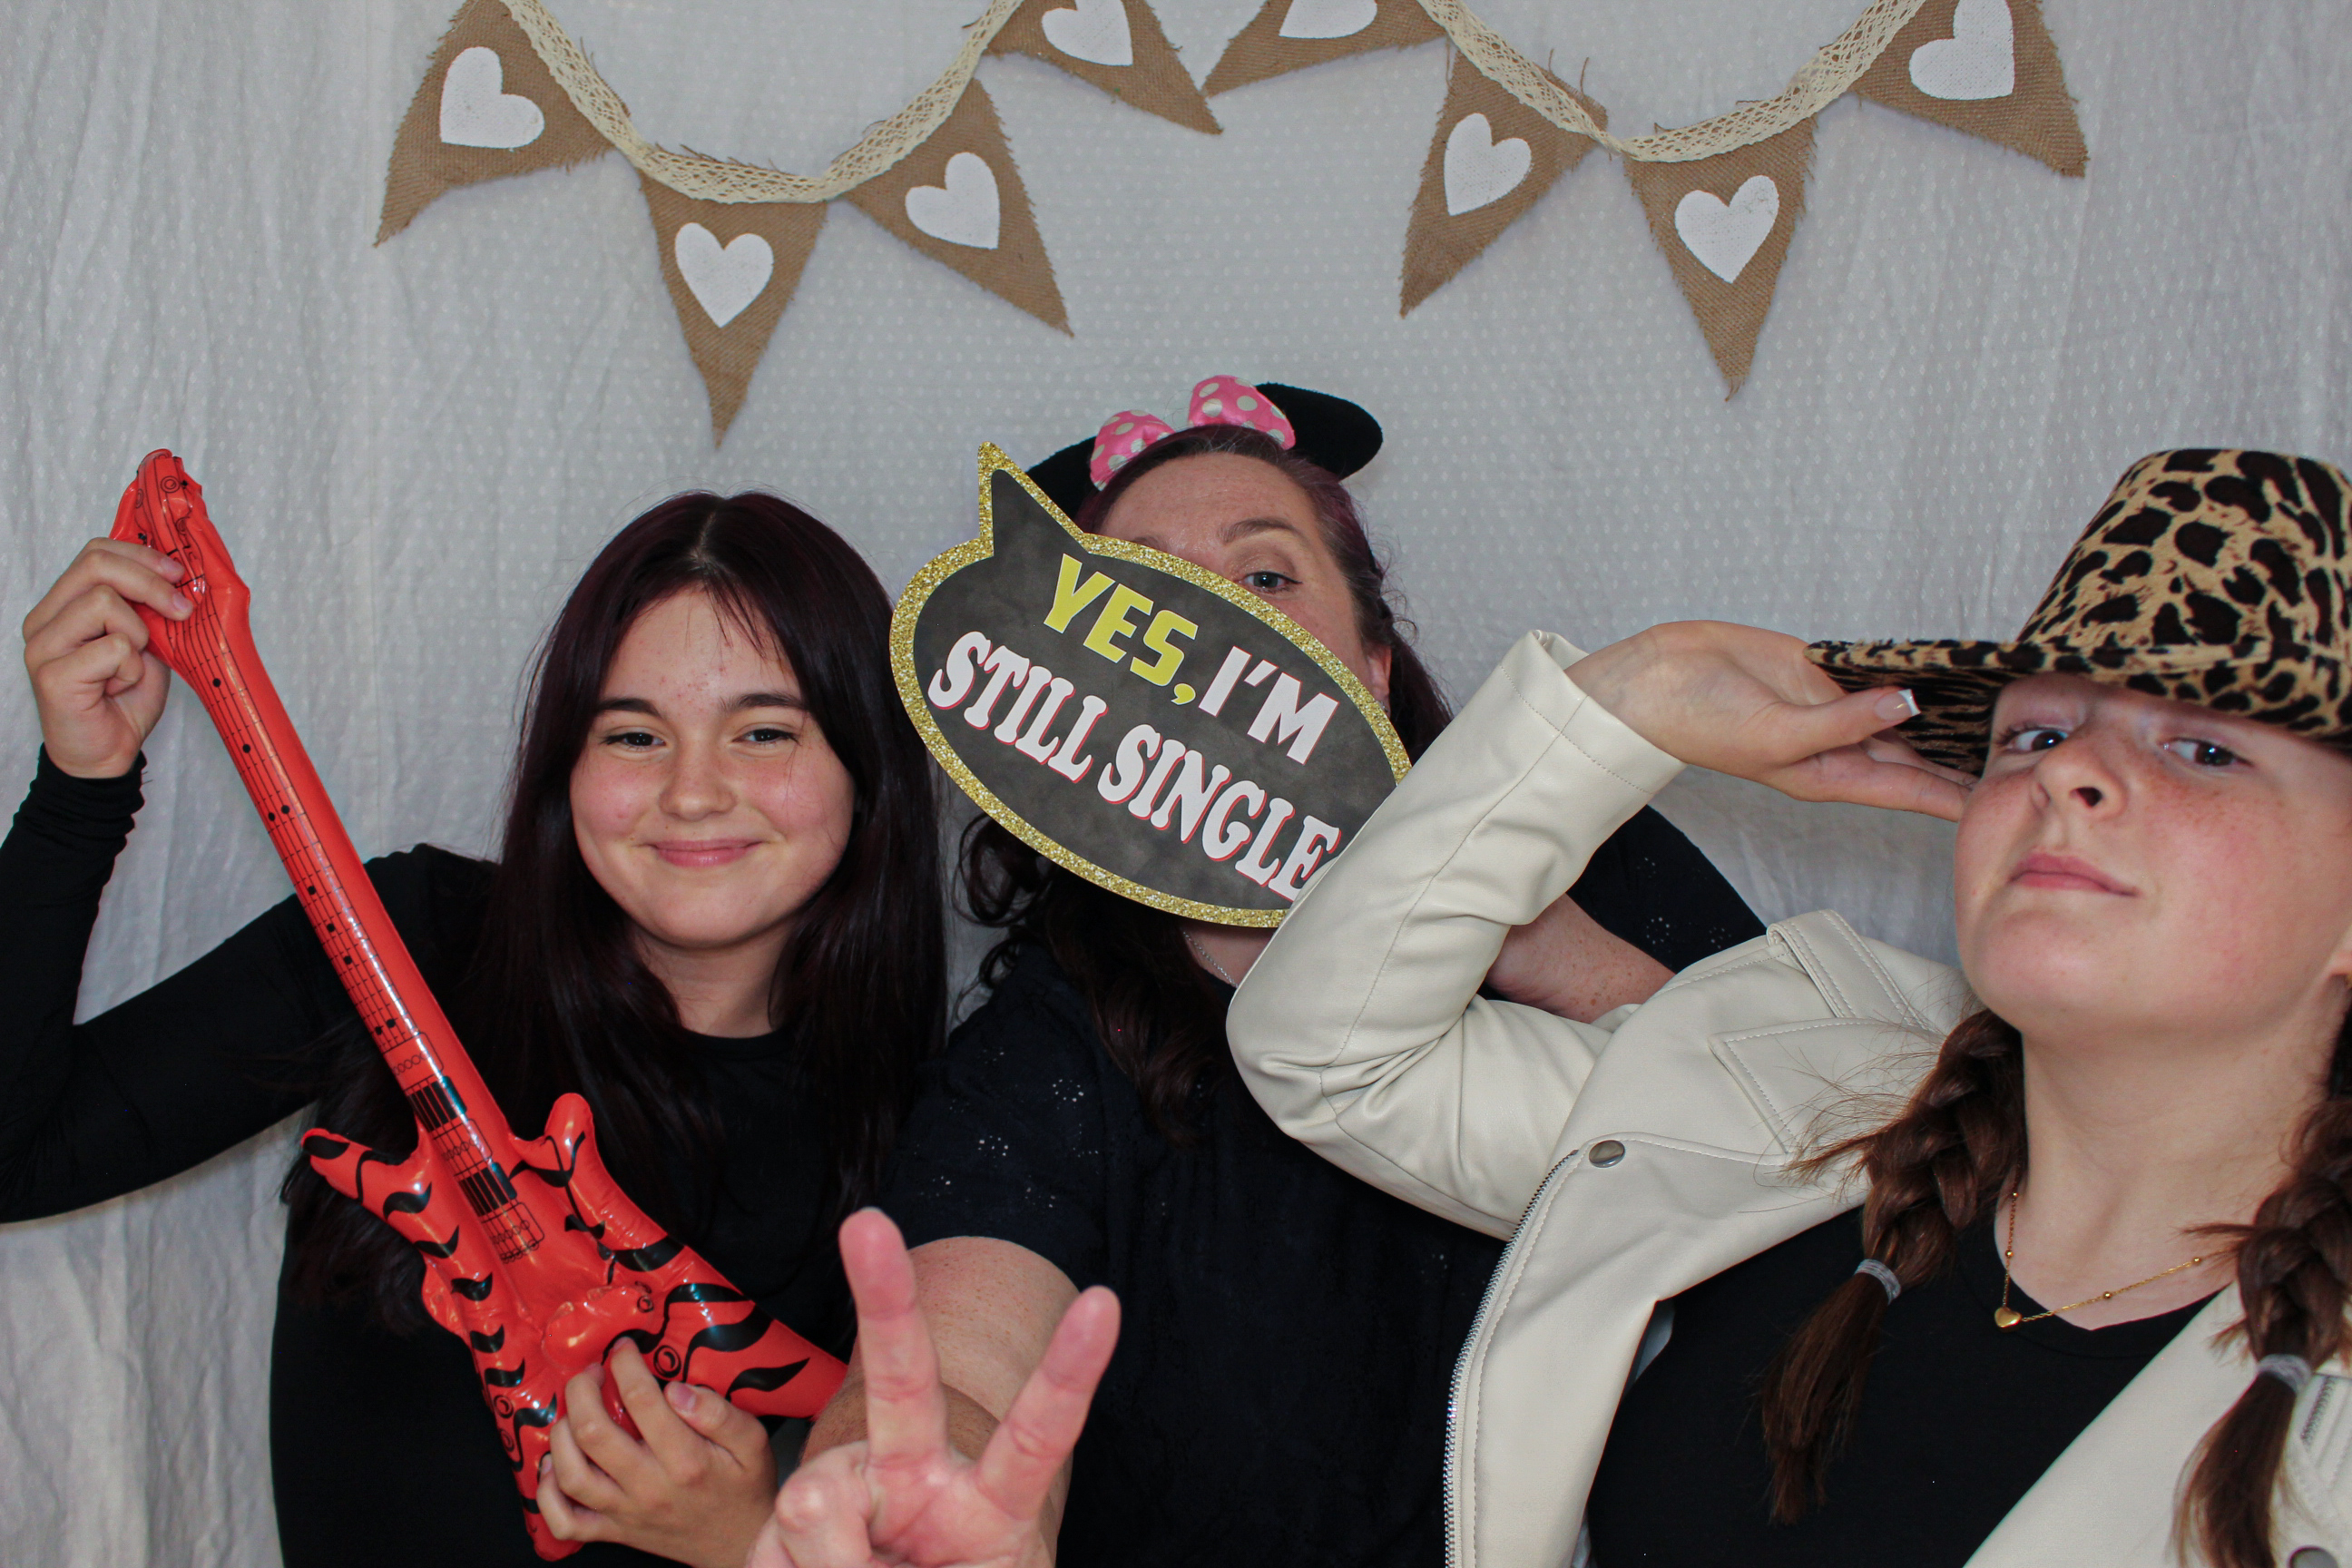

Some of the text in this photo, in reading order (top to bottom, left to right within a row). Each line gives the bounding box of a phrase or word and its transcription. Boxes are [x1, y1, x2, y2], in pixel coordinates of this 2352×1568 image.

[927, 631, 1342, 903] STILL SINGLE
[1044, 553, 1339, 764] YES, I'M
